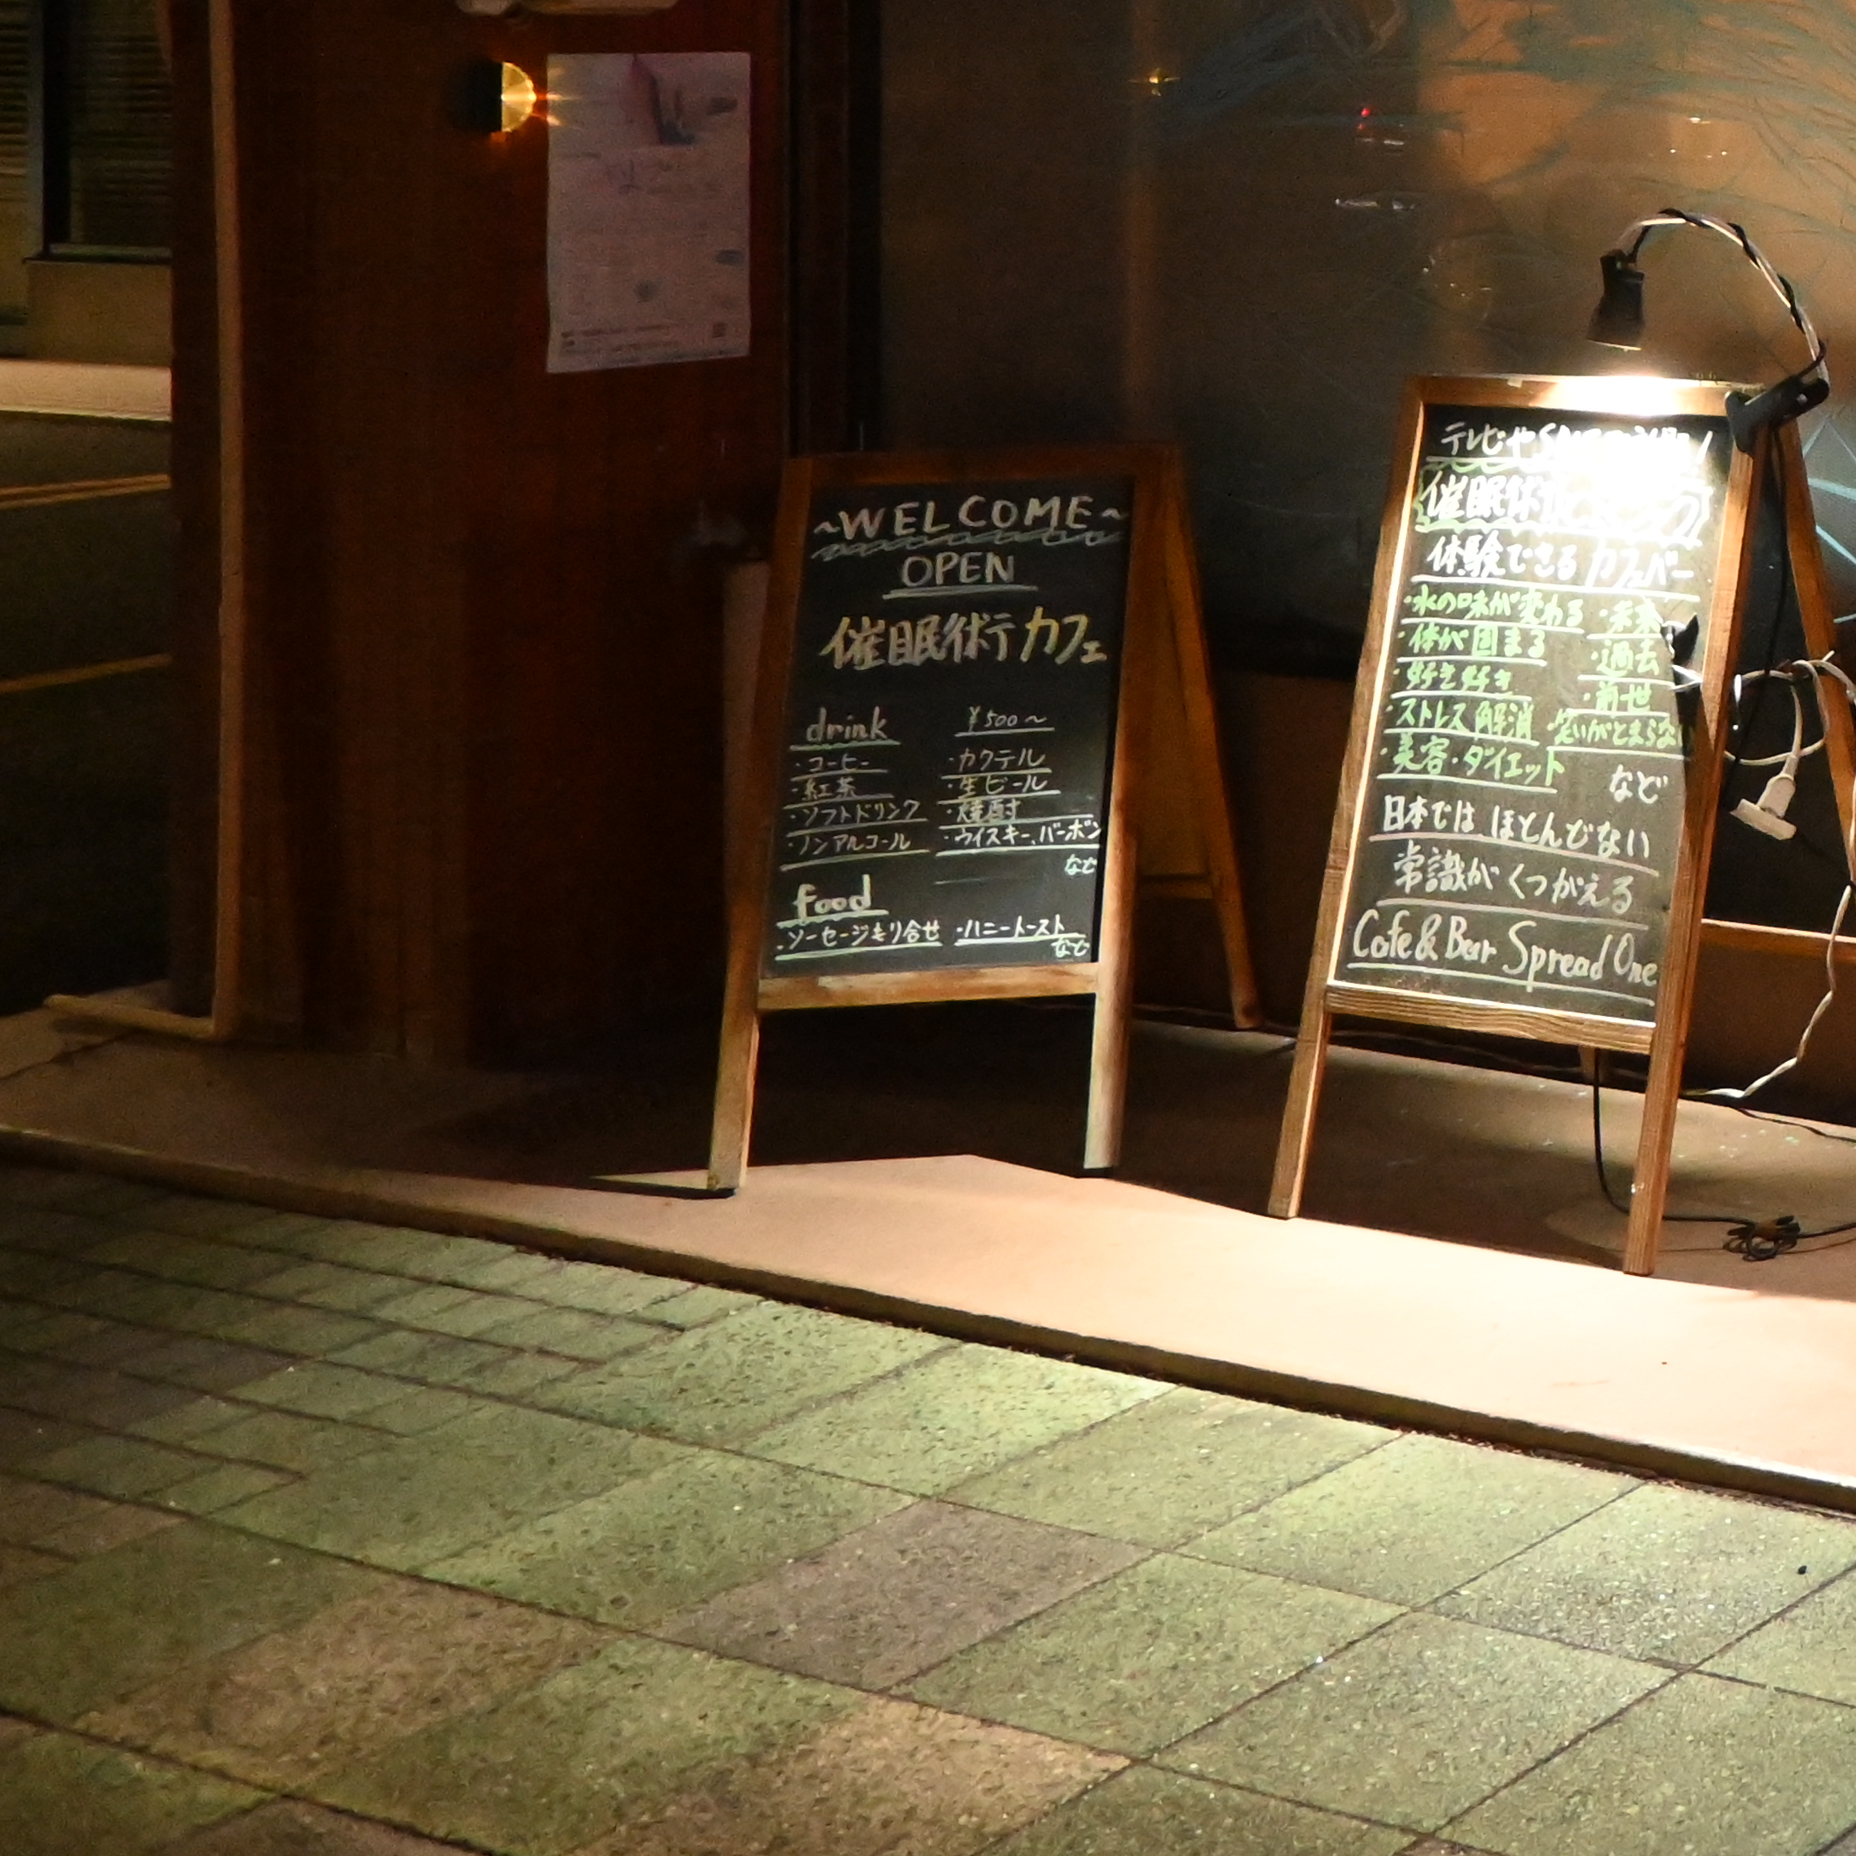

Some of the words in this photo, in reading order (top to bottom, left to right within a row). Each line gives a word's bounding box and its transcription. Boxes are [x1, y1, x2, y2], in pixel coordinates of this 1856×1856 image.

[902, 551, 1016, 588] OPEN
[1412, 584, 1584, 627] 水の味が変わる
[806, 706, 888, 742] drink
[1397, 697, 1536, 742] ストレス解消
[808, 753, 870, 772] コーヒー
[959, 748, 1046, 771] カクテル
[959, 776, 1047, 799] 生ビール
[1609, 764, 1668, 803] など
[802, 799, 920, 826] ソフトドリンク
[800, 833, 911, 855] ノンアルコール
[792, 874, 872, 922] food
[964, 914, 1065, 938] ハニートースト
[1503, 920, 1613, 992] Spread
[1614, 932, 1658, 987] One
